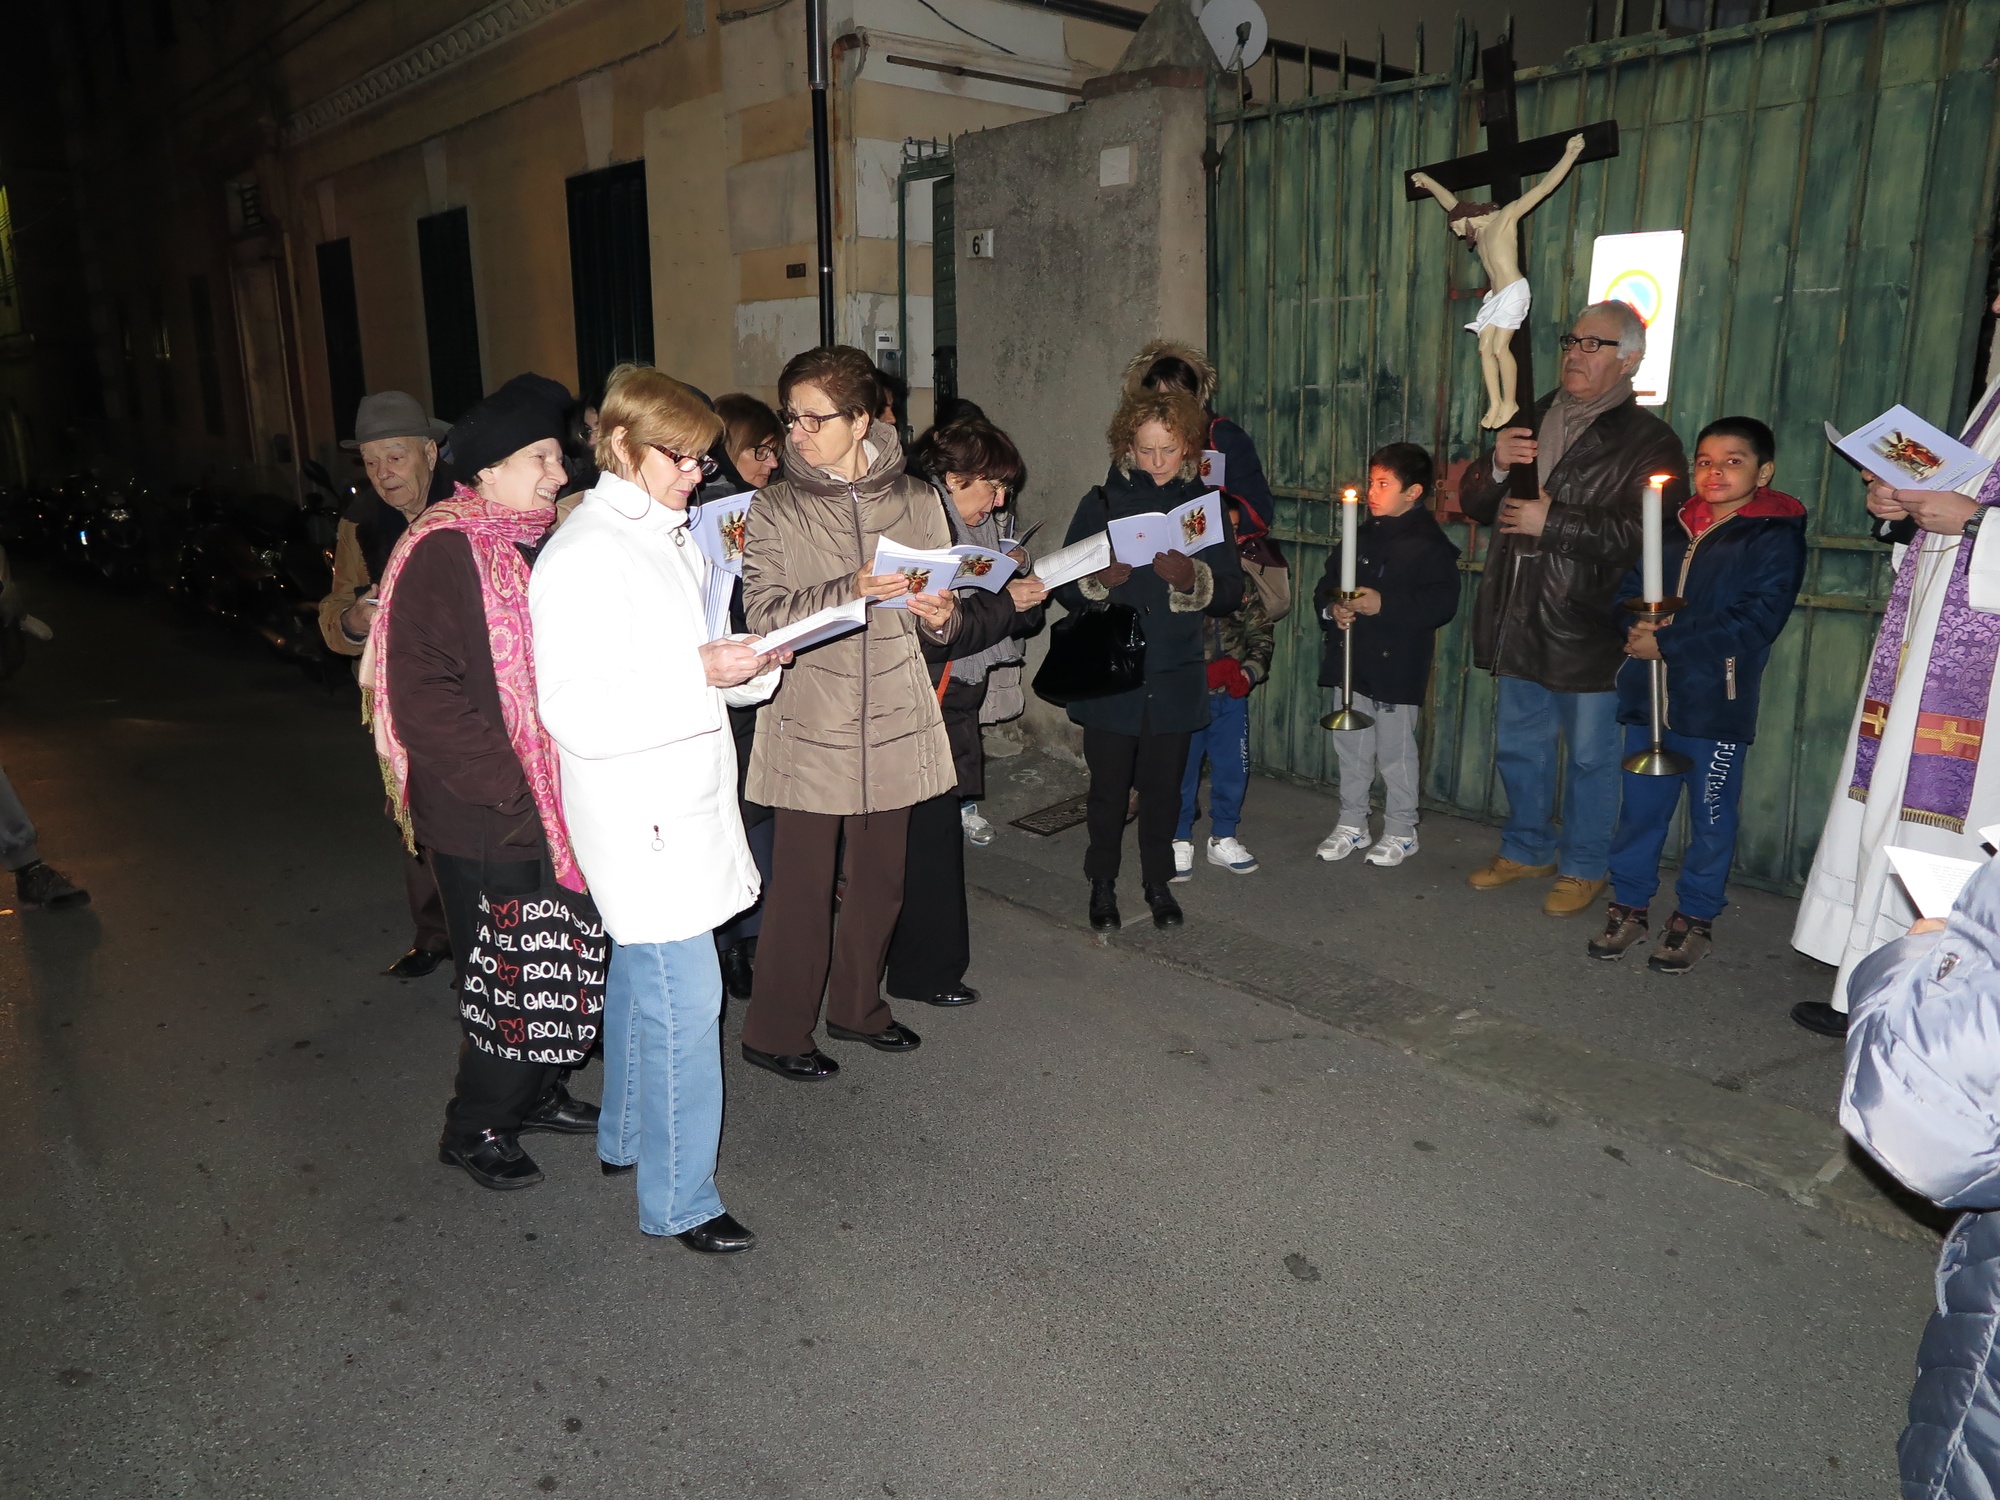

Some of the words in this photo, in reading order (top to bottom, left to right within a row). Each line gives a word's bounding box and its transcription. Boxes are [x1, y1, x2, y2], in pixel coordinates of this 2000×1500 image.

[1708, 741, 1736, 825] FOOTBALL
[522, 899, 571, 922] ISOLA
[522, 961, 573, 982] ISOLA
[494, 987, 521, 1011] DEL
[523, 990, 578, 1011] GIGLIO
[527, 1021, 574, 1041] ISOLA
[527, 1048, 585, 1064] GIGLIO
